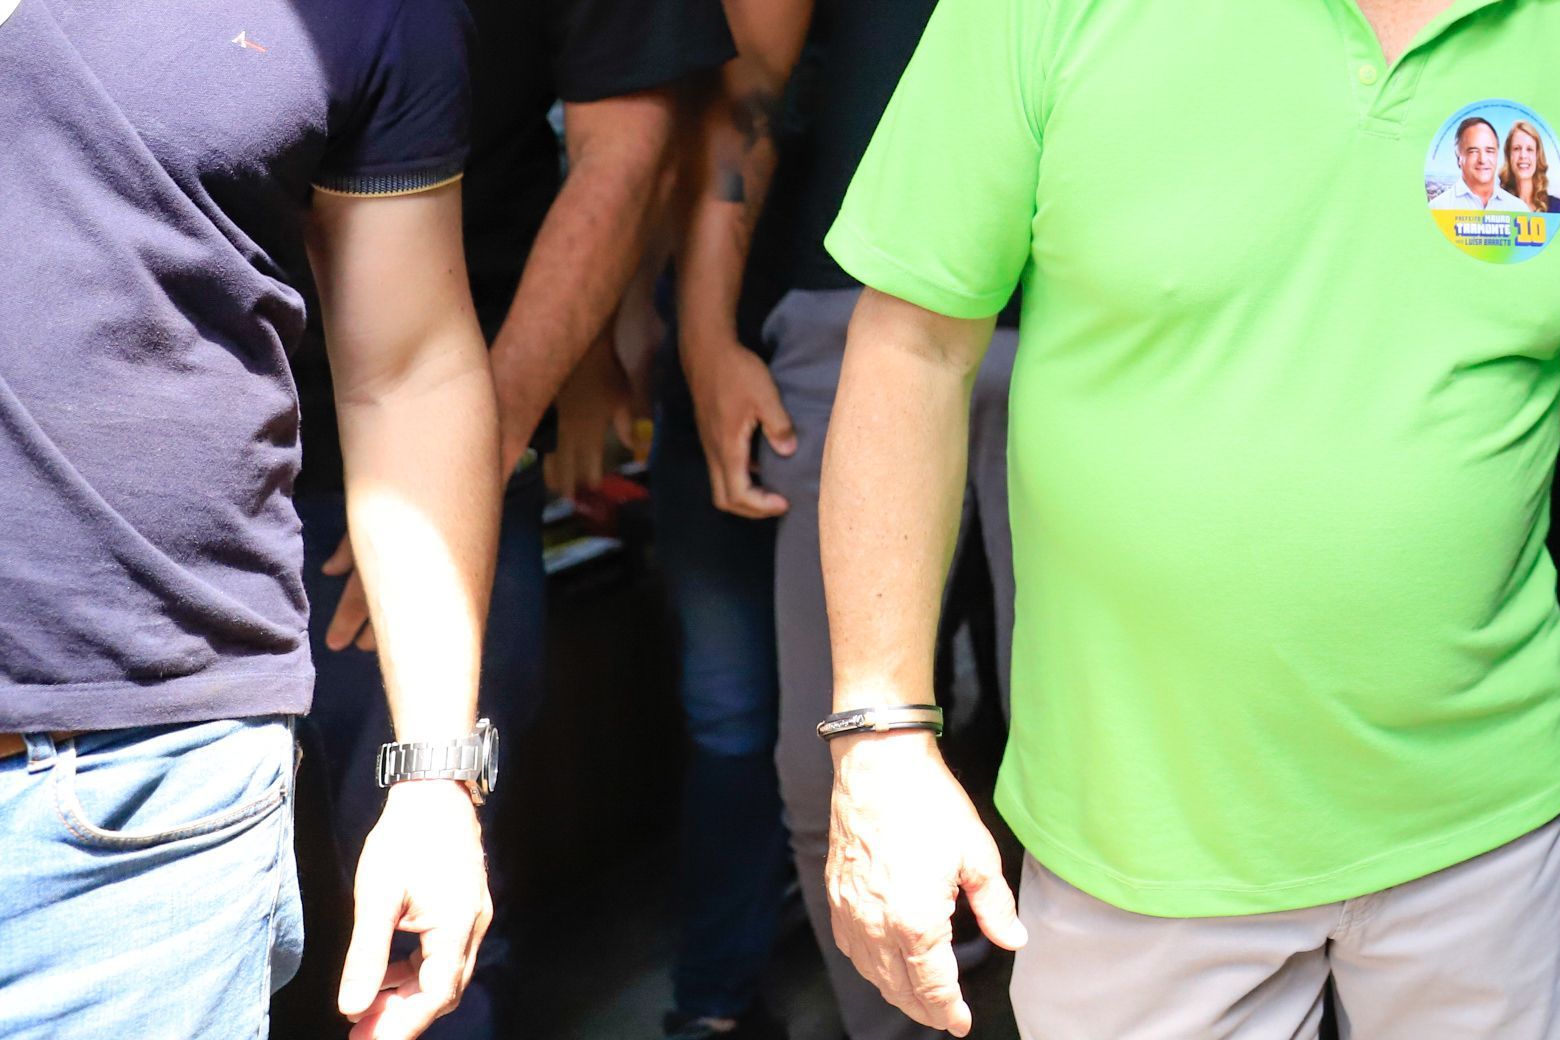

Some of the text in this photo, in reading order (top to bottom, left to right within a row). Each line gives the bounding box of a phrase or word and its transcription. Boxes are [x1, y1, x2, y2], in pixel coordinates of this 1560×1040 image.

[1483, 215, 1511, 224] MAURO
[1455, 223, 1511, 236] TRAMONTE
[1515, 216, 1546, 246] 10
